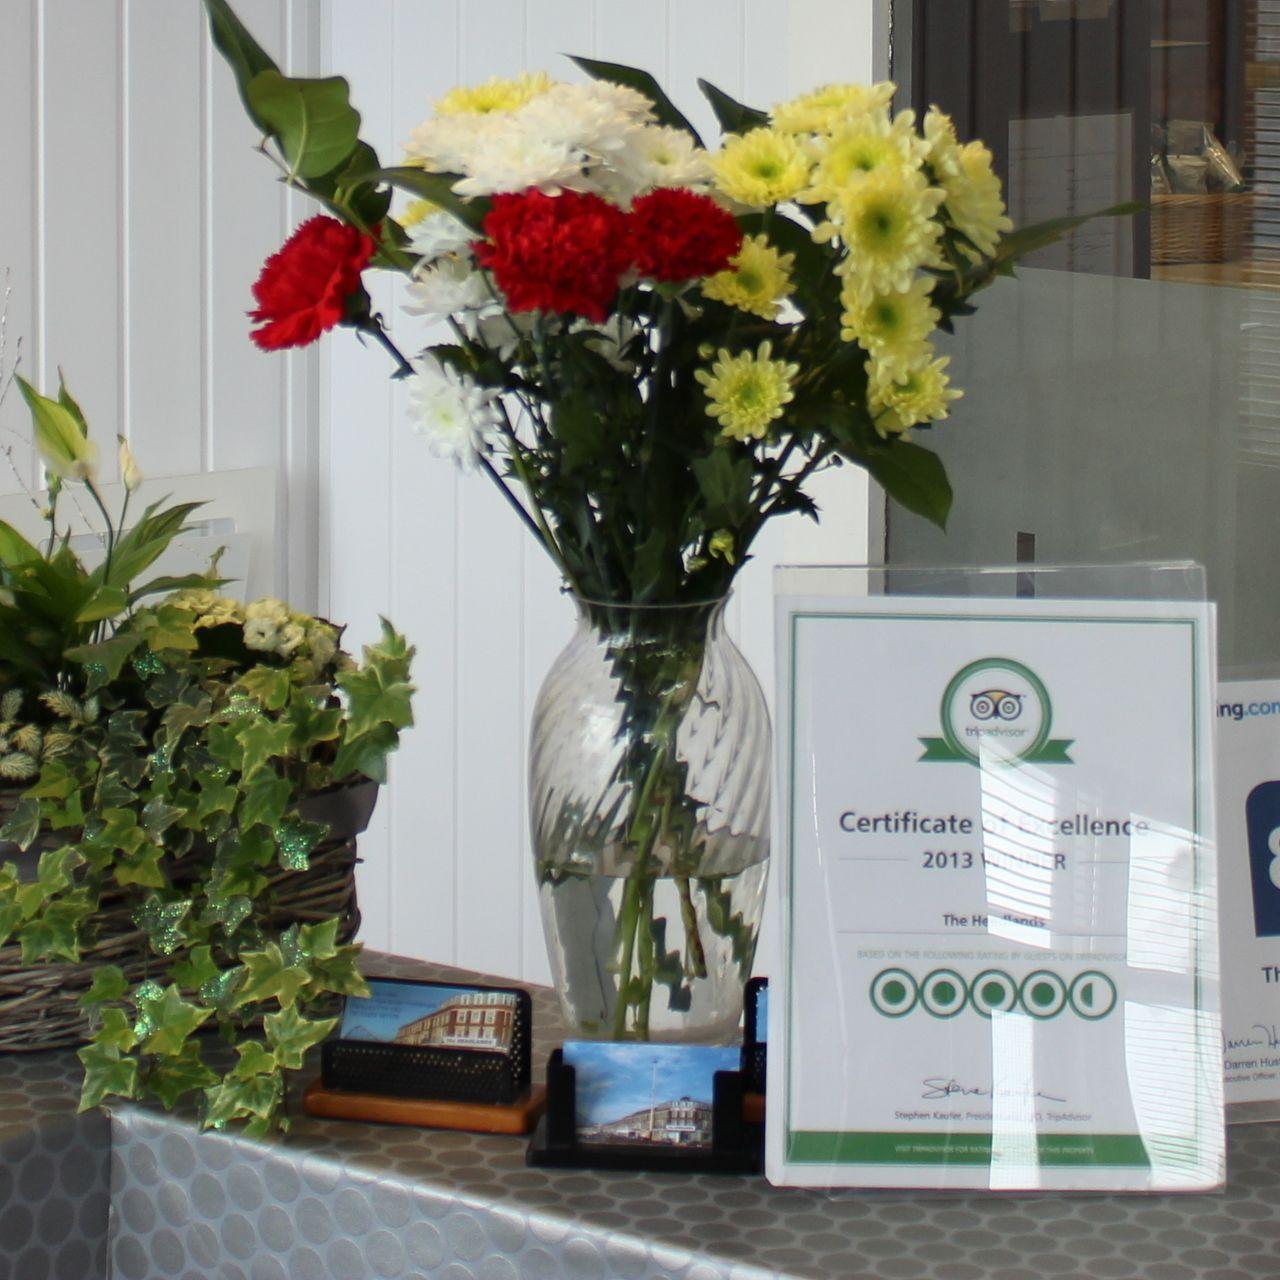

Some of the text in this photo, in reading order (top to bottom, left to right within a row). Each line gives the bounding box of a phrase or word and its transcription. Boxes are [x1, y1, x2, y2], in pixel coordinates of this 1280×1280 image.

[965, 726, 1025, 739] tripadvisor
[839, 811, 973, 834] Certificate
[922, 852, 973, 870] 2013
[943, 914, 1046, 929] The Helands
[1223, 1059, 1258, 1070] Darren
